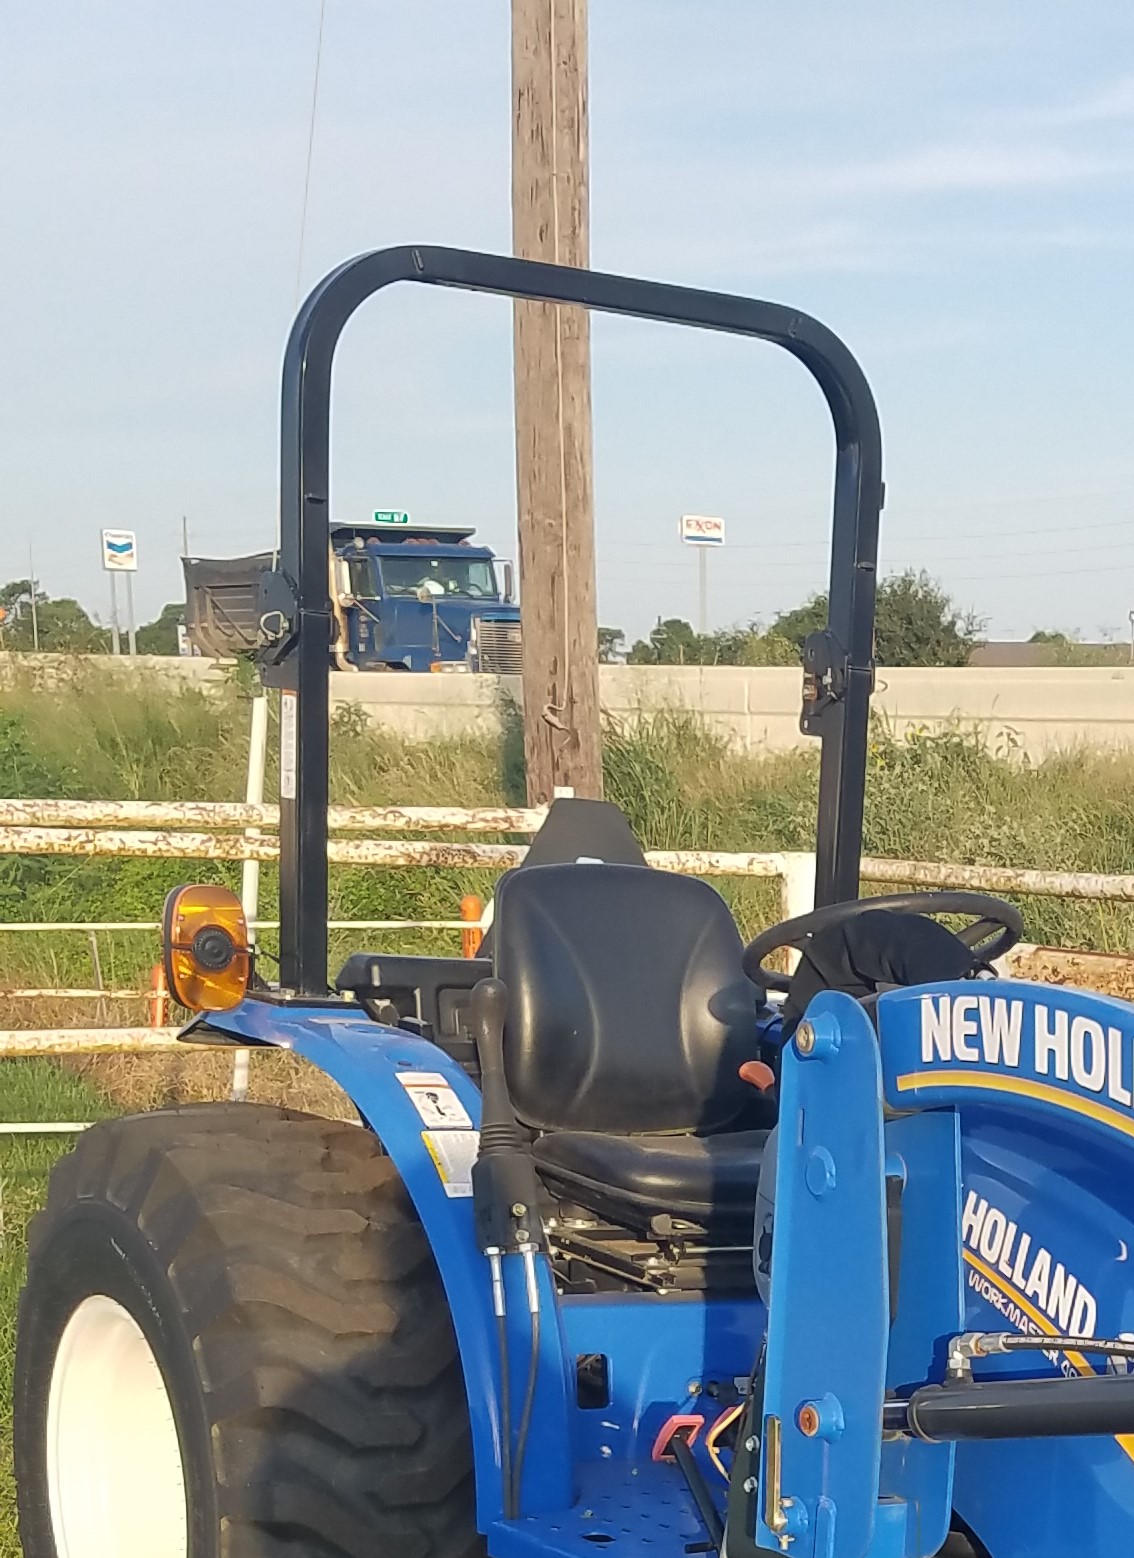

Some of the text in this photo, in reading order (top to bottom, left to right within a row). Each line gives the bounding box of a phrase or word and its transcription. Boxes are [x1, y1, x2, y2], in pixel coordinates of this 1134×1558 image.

[920, 994, 1023, 1068] NEW
[963, 1190, 1097, 1338] HOLLAND
[968, 1269, 1059, 1367] WORKMASR
